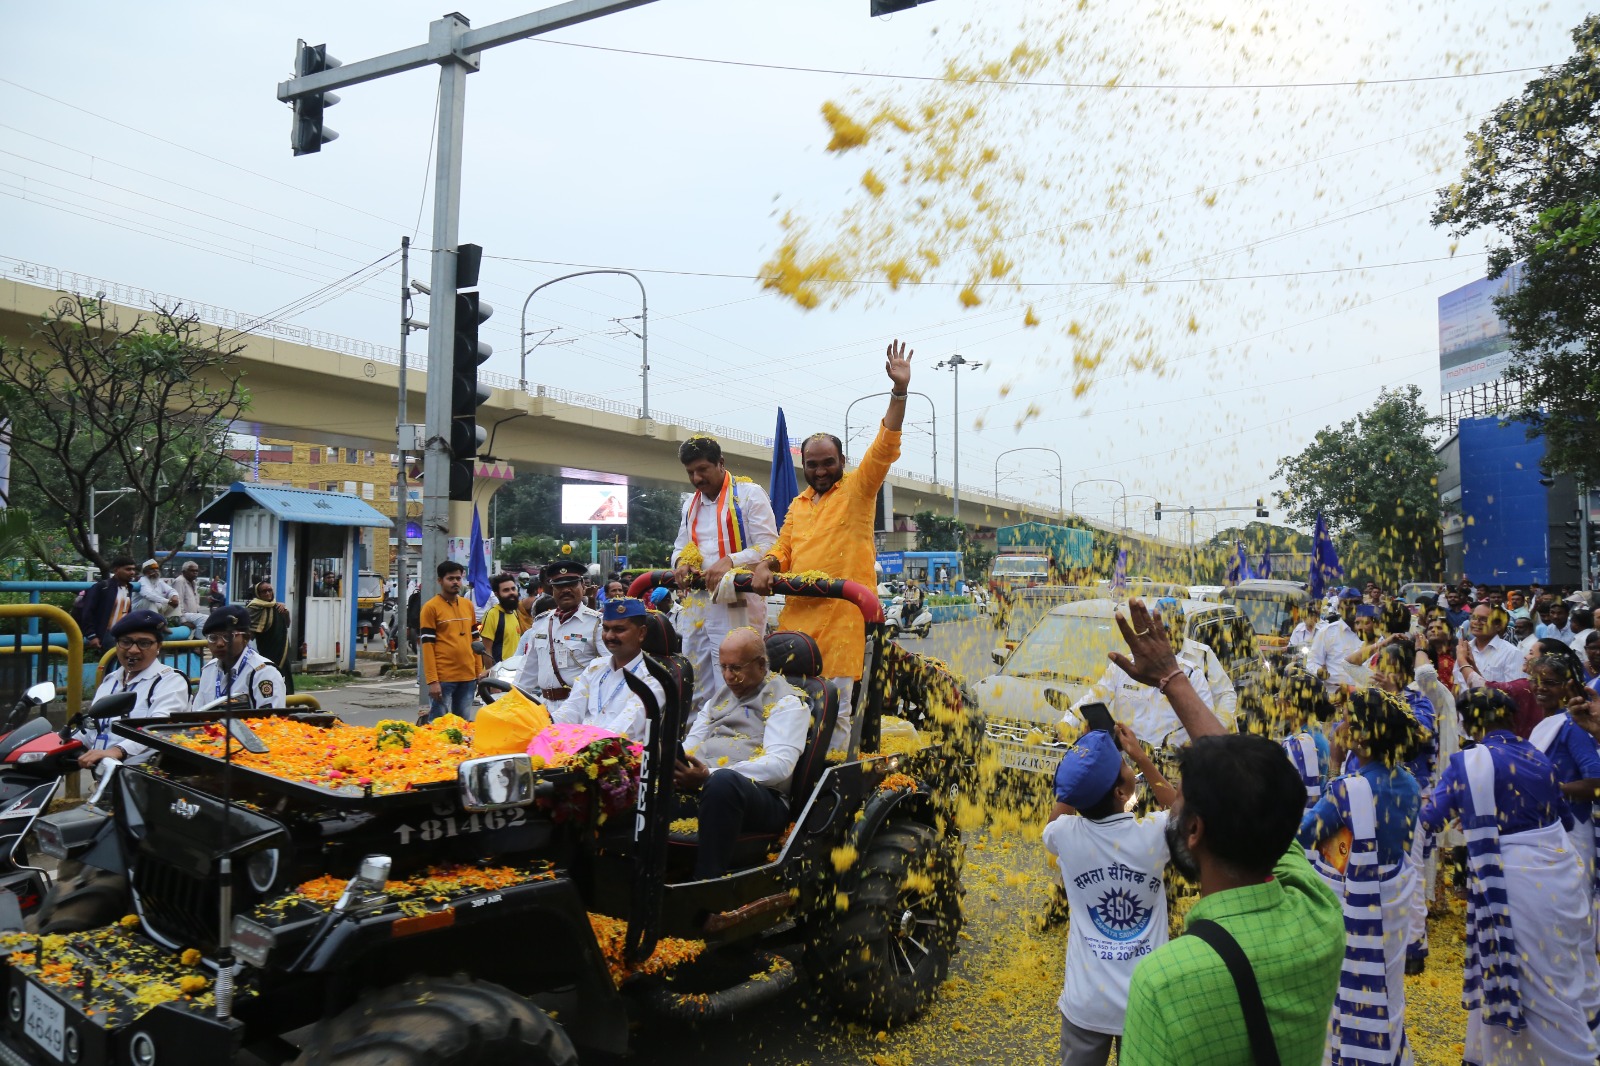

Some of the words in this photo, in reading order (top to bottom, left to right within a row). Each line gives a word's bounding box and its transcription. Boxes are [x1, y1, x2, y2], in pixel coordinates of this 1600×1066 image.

[1446, 361, 1486, 379] mahindra
[634, 718, 652, 842] JEEP
[420, 807, 527, 841] 81462
[1074, 868, 1105, 889] समता
[1108, 862, 1147, 884] सैनिक
[1106, 896, 1133, 920] SSD
[1095, 917, 1118, 938] SAMATA
[1119, 928, 1140, 939] SAINIK
[1139, 916, 1149, 928] DAL
[1100, 951, 1113, 960] 28
[27, 1011, 63, 1052] 4649
